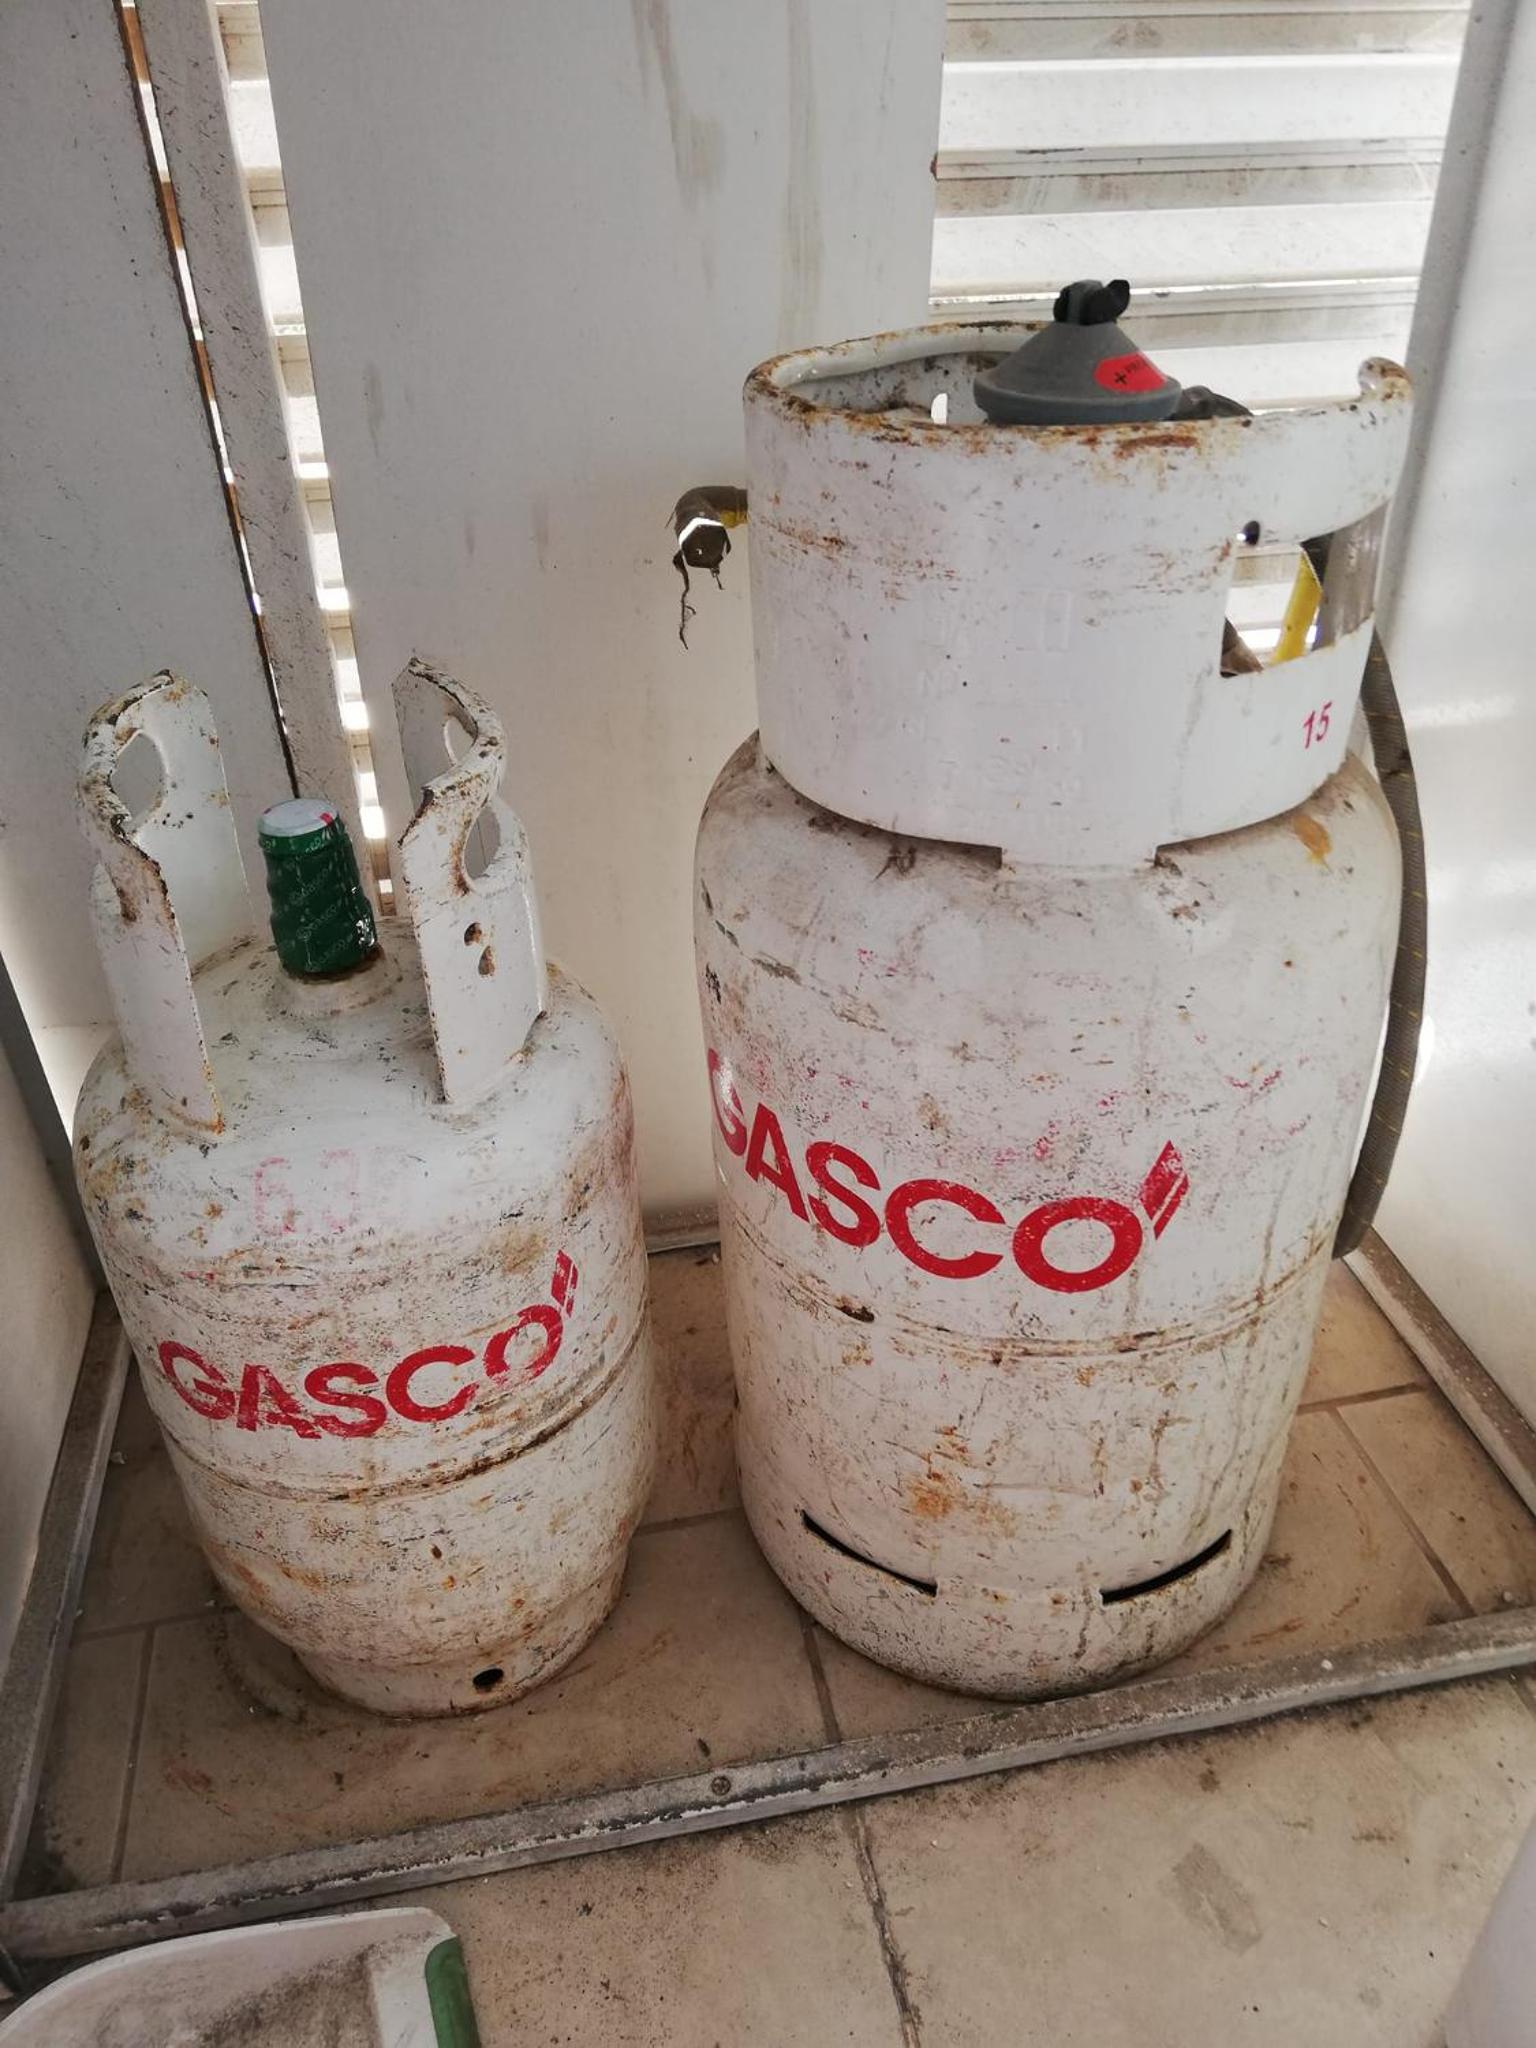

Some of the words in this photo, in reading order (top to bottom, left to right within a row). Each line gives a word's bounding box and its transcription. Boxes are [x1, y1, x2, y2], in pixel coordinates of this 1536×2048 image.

[1303, 701, 1332, 749] 15
[708, 1048, 1142, 1293] GASCO
[157, 1304, 564, 1439] GASCO
